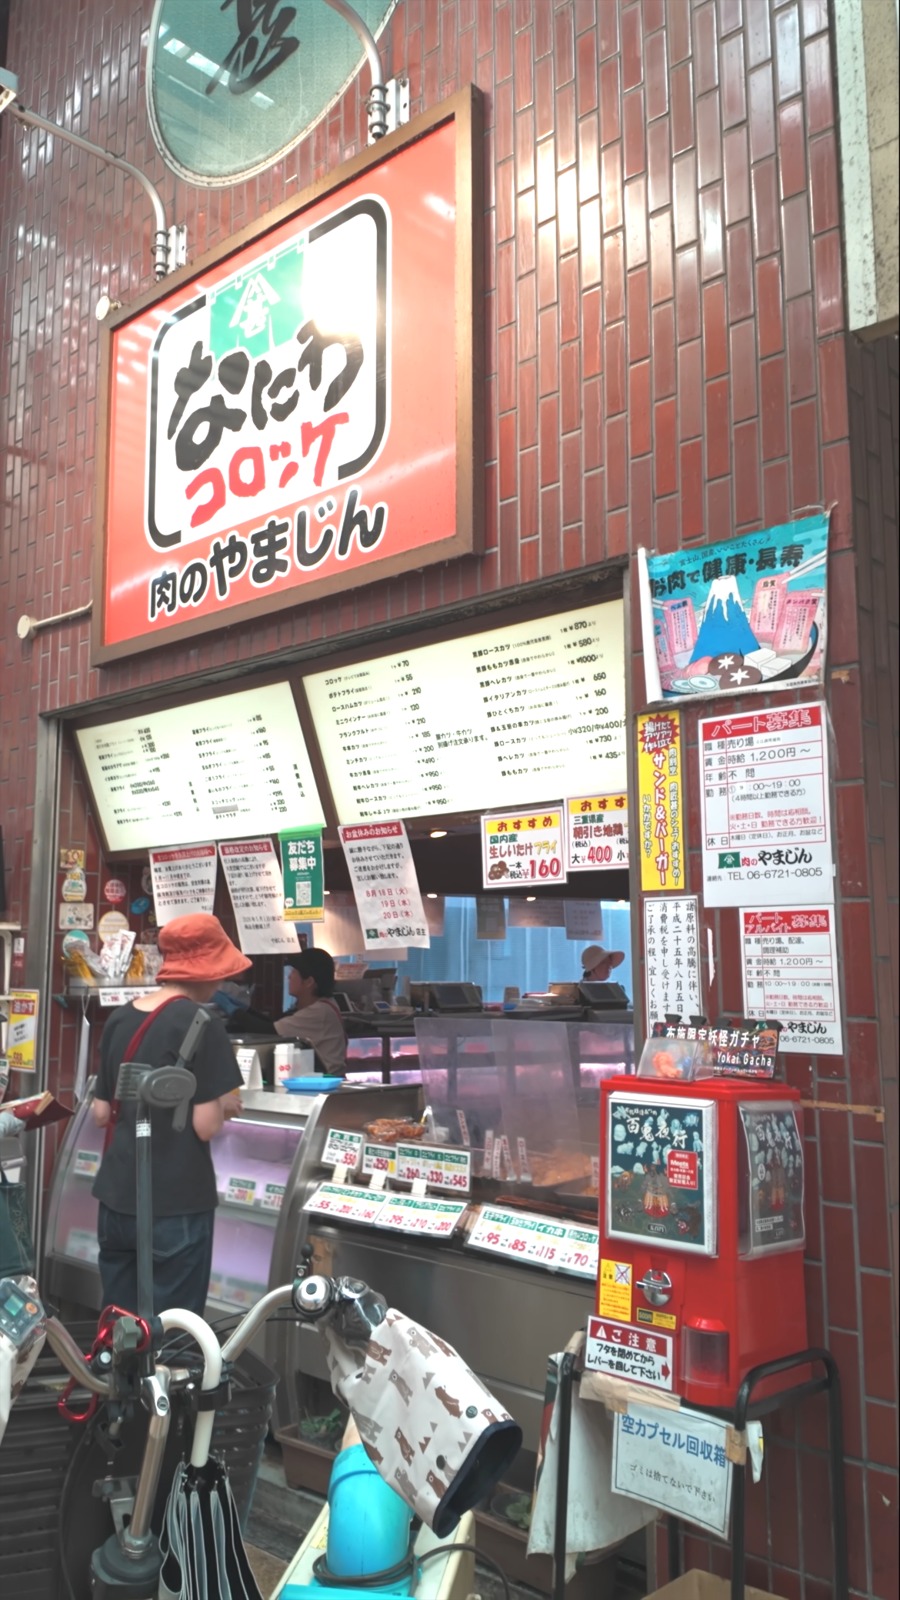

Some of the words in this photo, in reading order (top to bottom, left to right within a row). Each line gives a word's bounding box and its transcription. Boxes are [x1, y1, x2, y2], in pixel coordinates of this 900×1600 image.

[167, 320, 364, 471] なにわ
[185, 412, 349, 528] コロッケ
[149, 490, 385, 618] 肉のやまじん
[649, 543, 804, 597] お肉で健康・長寿
[324, 676, 342, 686] コロッケ
[328, 688, 355, 699] ポテトフライ
[331, 700, 362, 712] ロースハムカツ
[335, 715, 366, 726] ミニウインナー
[644, 721, 671, 733] 揚げたて
[711, 708, 811, 737] パート募集
[339, 727, 370, 739] フランクフルト
[643, 730, 672, 742] アツアツ
[727, 737, 754, 750] 売り場
[346, 757, 368, 766] ミンチカツ
[727, 753, 746, 765] 時給
[497, 816, 553, 832] おすすめ
[574, 814, 604, 825] 三重県産
[652, 752, 669, 886] サンド&バーガー
[345, 825, 398, 839] お盆休みのお知らせ
[489, 834, 518, 844] 国内産
[287, 840, 315, 855] 友だち
[489, 840, 558, 859] 生しいたけフライ
[288, 857, 316, 871] 募集中
[741, 848, 812, 867] 肉のやまじん
[509, 871, 522, 879] 税込
[728, 871, 745, 881] TEL
[747, 868, 823, 880] 06-6721-0805
[745, 924, 791, 934] アルバイト
[791, 914, 827, 928] 募集
[749, 912, 783, 923] パート
[660, 902, 671, 1012] 消費税を申し受けます
[672, 902, 684, 1012] 平成二十五年八月五日
[686, 901, 700, 1008] 諸原料の高騰に伴い、
[717, 1052, 740, 1064] Yokai
[743, 1053, 772, 1066] Gacha
[626, 1118, 688, 1149] 百鬼夜行
[611, 1329, 657, 1352] ご注意
[596, 1343, 655, 1366] フタを閉めてから
[587, 1355, 661, 1380] レバーを回して下さい
[621, 1414, 726, 1468] 空カプセル回収箱
